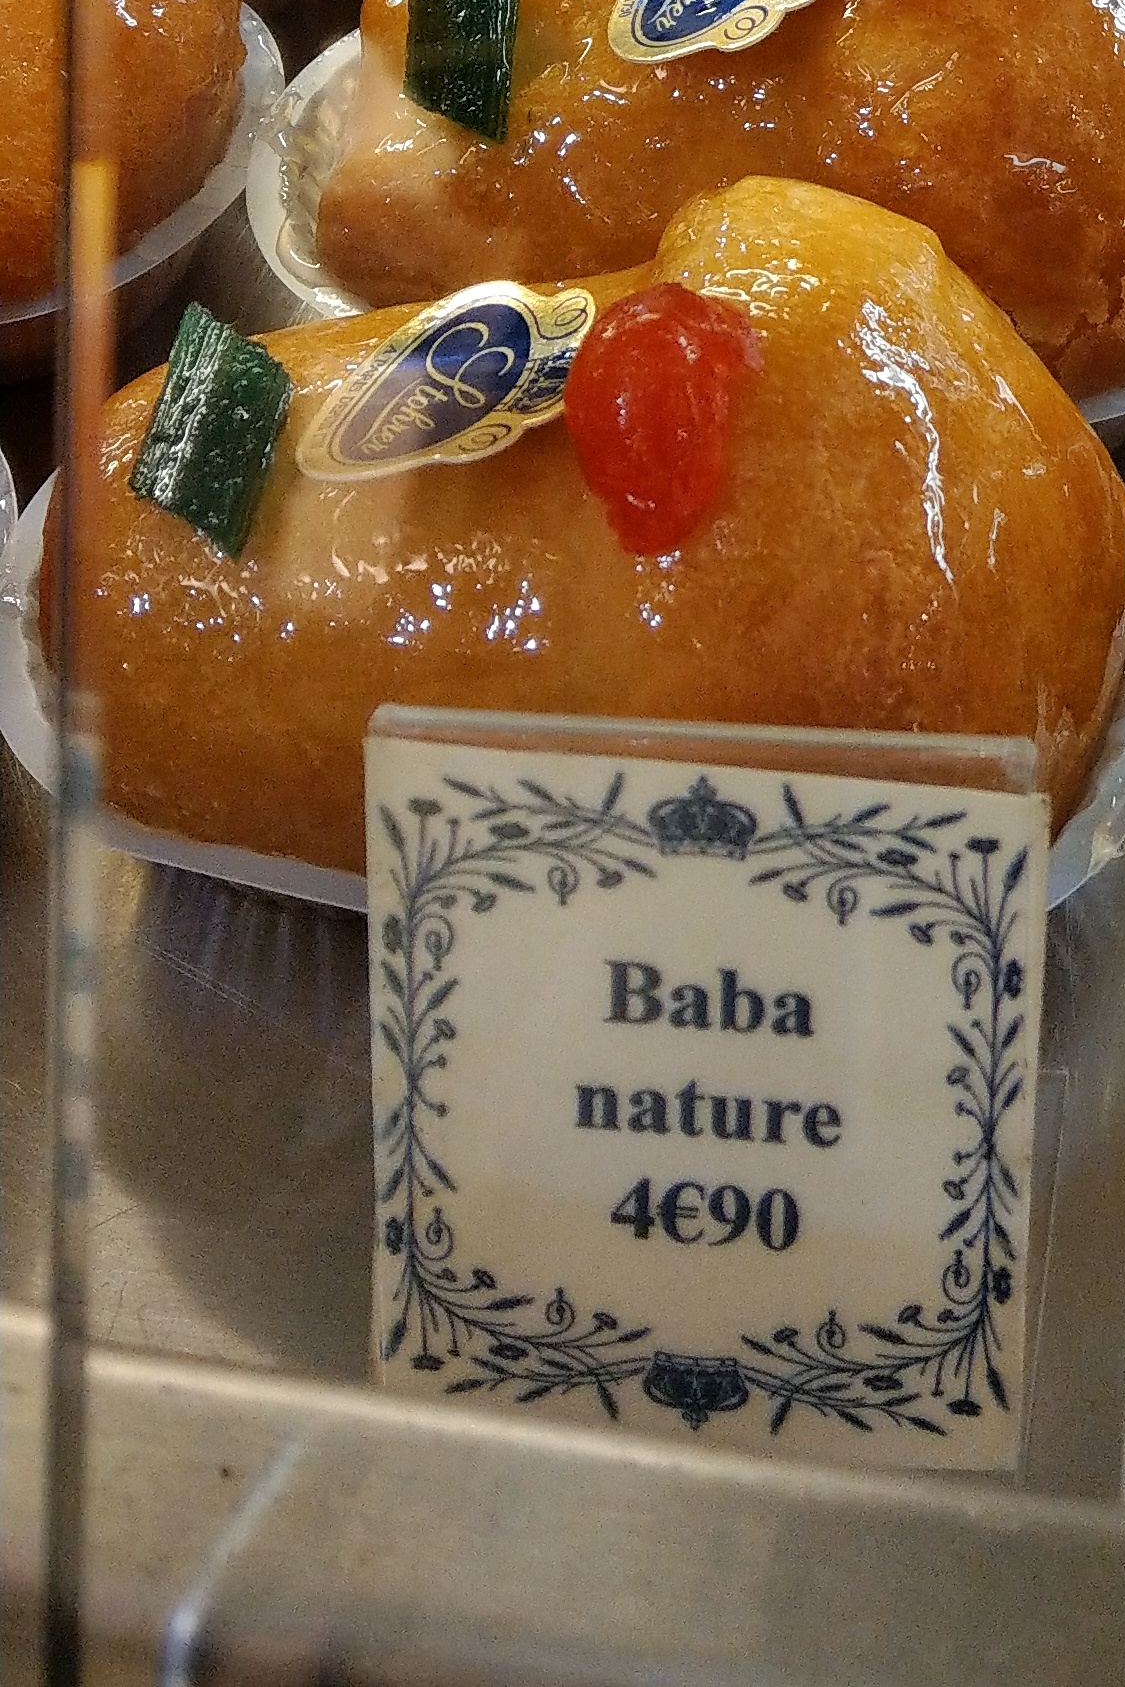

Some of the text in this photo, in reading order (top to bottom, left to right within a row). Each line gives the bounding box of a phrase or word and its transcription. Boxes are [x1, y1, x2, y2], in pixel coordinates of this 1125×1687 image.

[604, 959, 815, 1038] Baba
[575, 1078, 843, 1148] nature
[610, 1178, 801, 1252] 4€90
